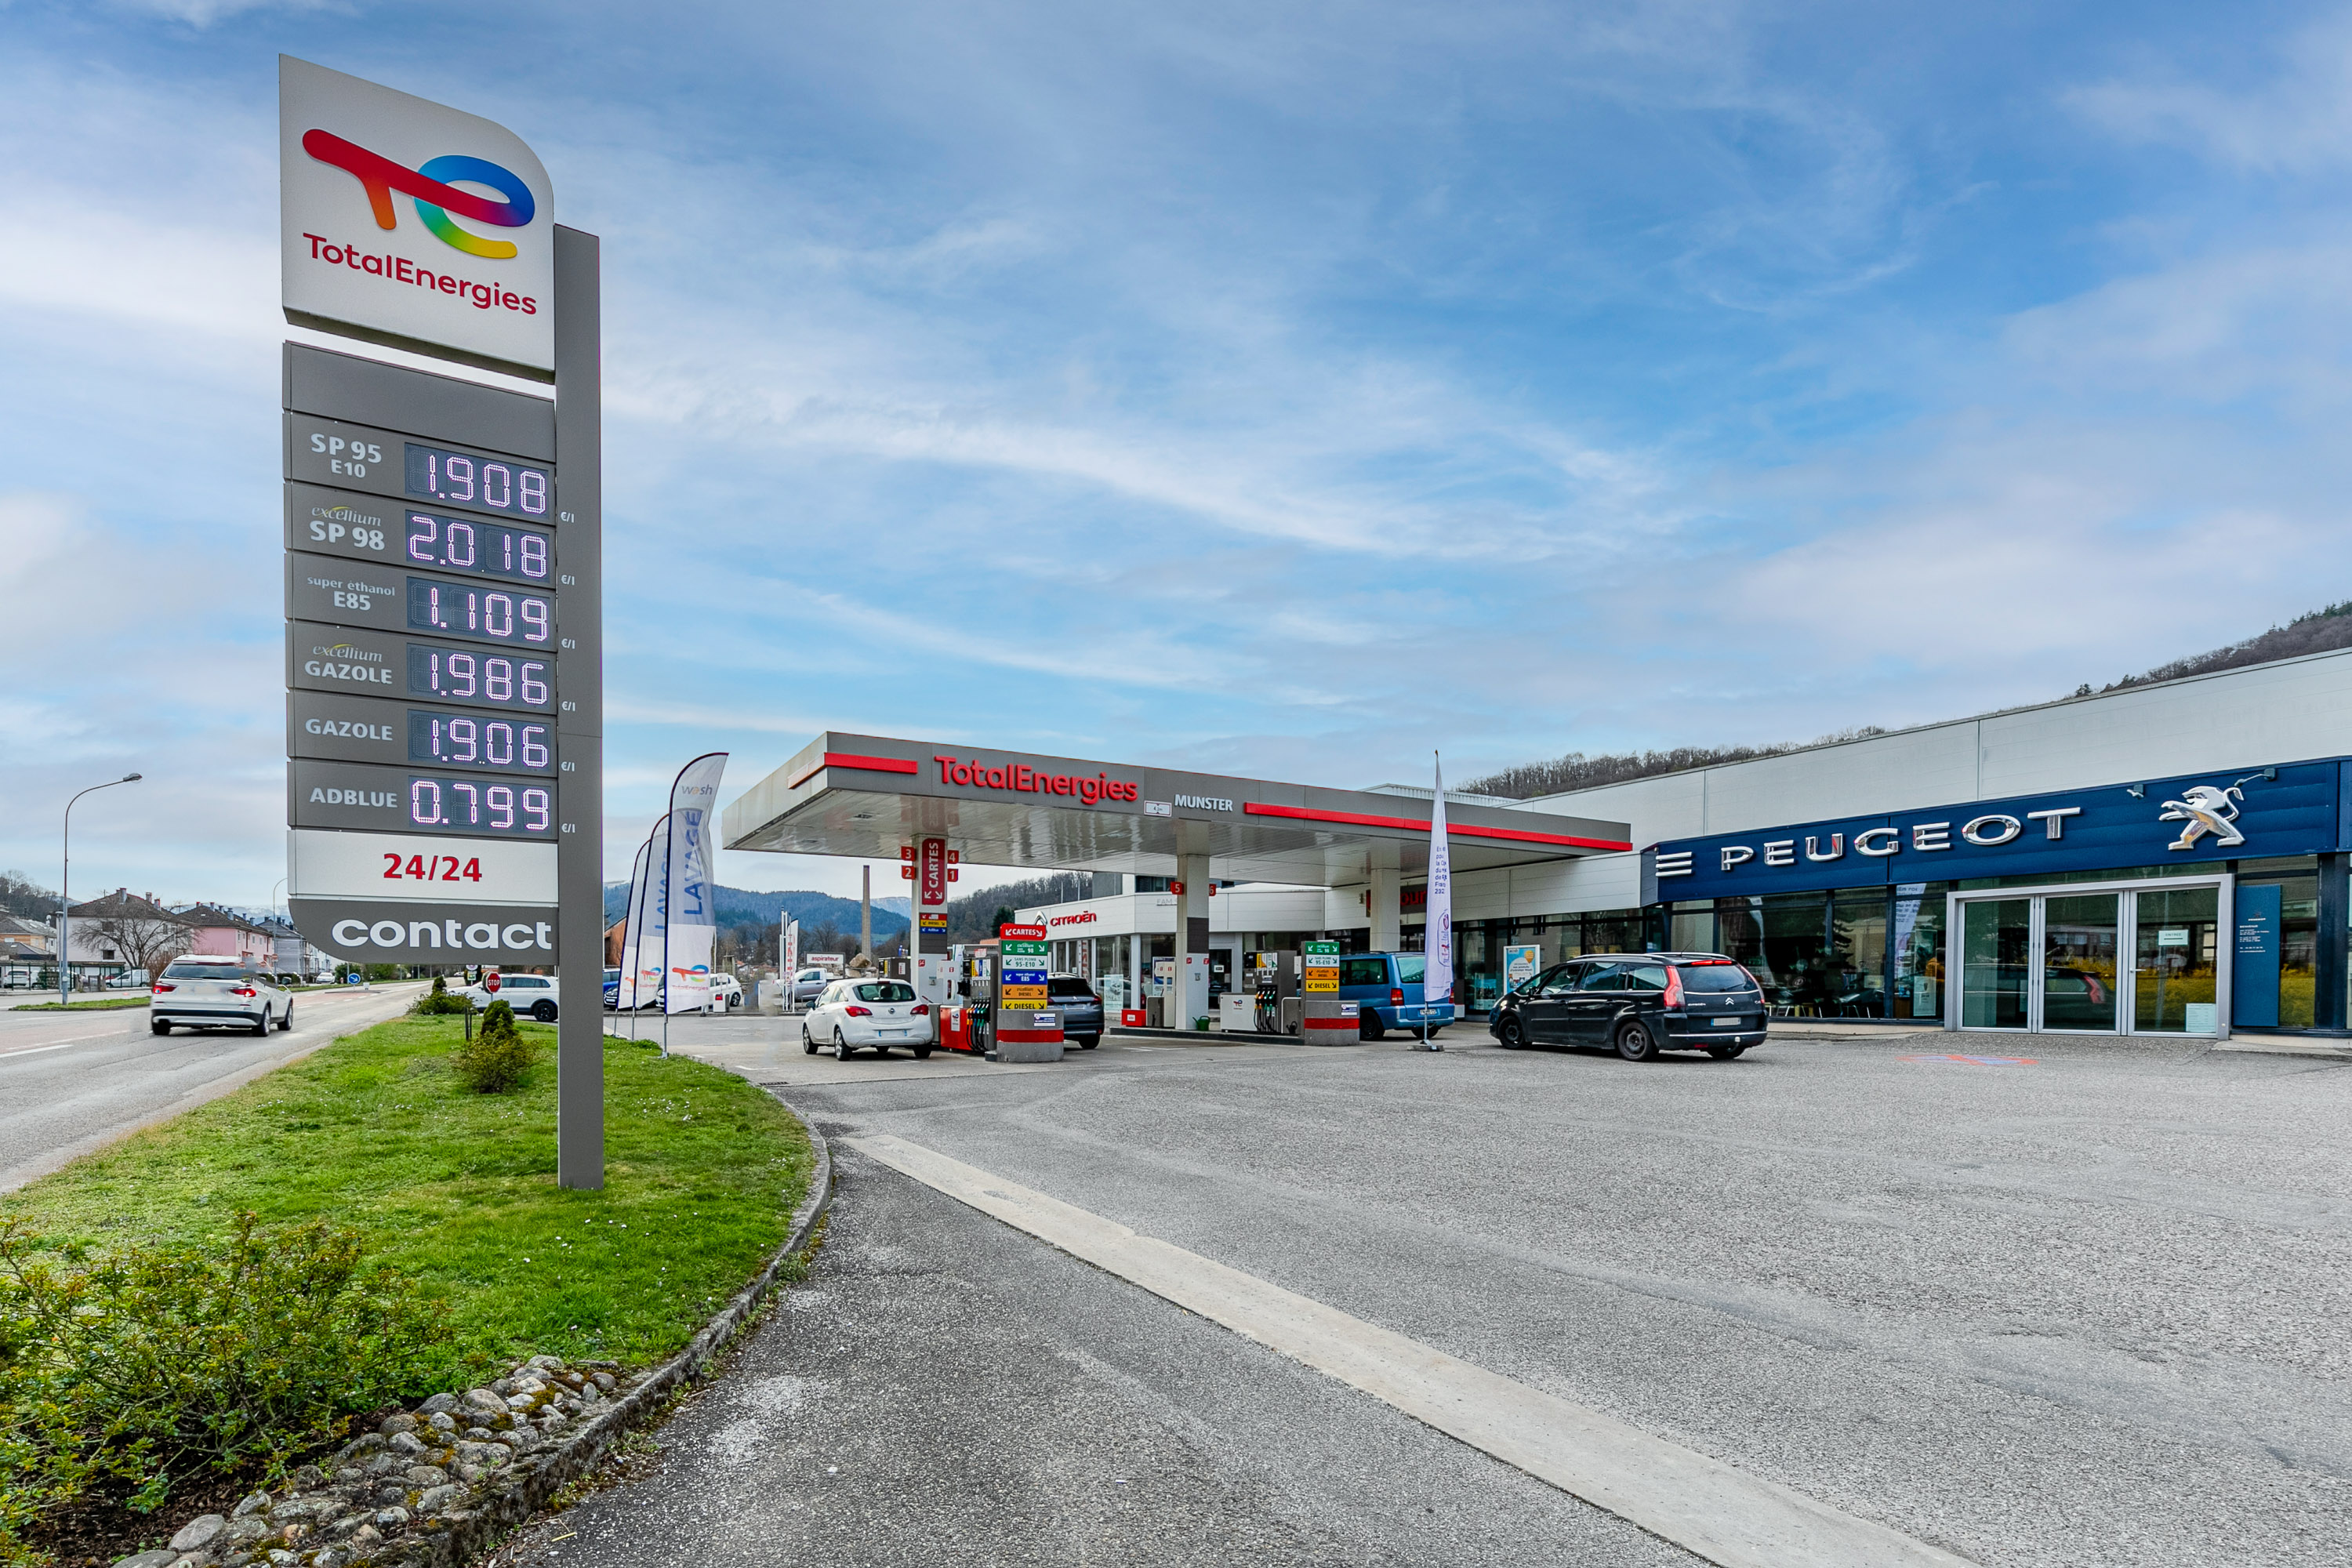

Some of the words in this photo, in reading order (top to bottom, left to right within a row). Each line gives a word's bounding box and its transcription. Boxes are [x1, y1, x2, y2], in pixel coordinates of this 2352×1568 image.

[303, 233, 537, 314] TotalEnergies
[310, 433, 345, 459] SP
[351, 441, 383, 463] 95
[331, 459, 366, 478] E10
[429, 455, 546, 514] 1.908
[311, 506, 381, 527] excellium
[310, 521, 346, 543] SP
[351, 527, 386, 550] 98
[409, 515, 547, 578] 2.018
[307, 575, 343, 590] super
[333, 590, 372, 612] E85
[430, 587, 548, 641] 1.109
[313, 644, 383, 663] excellium
[304, 660, 393, 684] GAZOLE
[430, 653, 548, 705] 1.986
[305, 718, 394, 741] GAZOLE
[432, 718, 548, 768] 1.906
[681, 784, 713, 796] wash
[934, 755, 1139, 806] TotalEnergies
[310, 787, 397, 808] ADBLUE
[412, 780, 550, 830] 0.799
[1174, 793, 1233, 812] MUNSTER
[1720, 806, 2082, 872] PEUGEOT
[684, 811, 703, 915] LAVAGE
[905, 848, 912, 859] 3
[928, 842, 938, 888] CARTES
[949, 852, 956, 862] 4
[383, 853, 483, 882] 24/24
[905, 867, 912, 877] 2
[949, 870, 955, 880] 1
[1174, 884, 1180, 893] 5
[1209, 886, 1214, 895] 6
[1050, 910, 1097, 927] CITROËN
[332, 919, 552, 950] contact
[1012, 927, 1036, 936] CARTES
